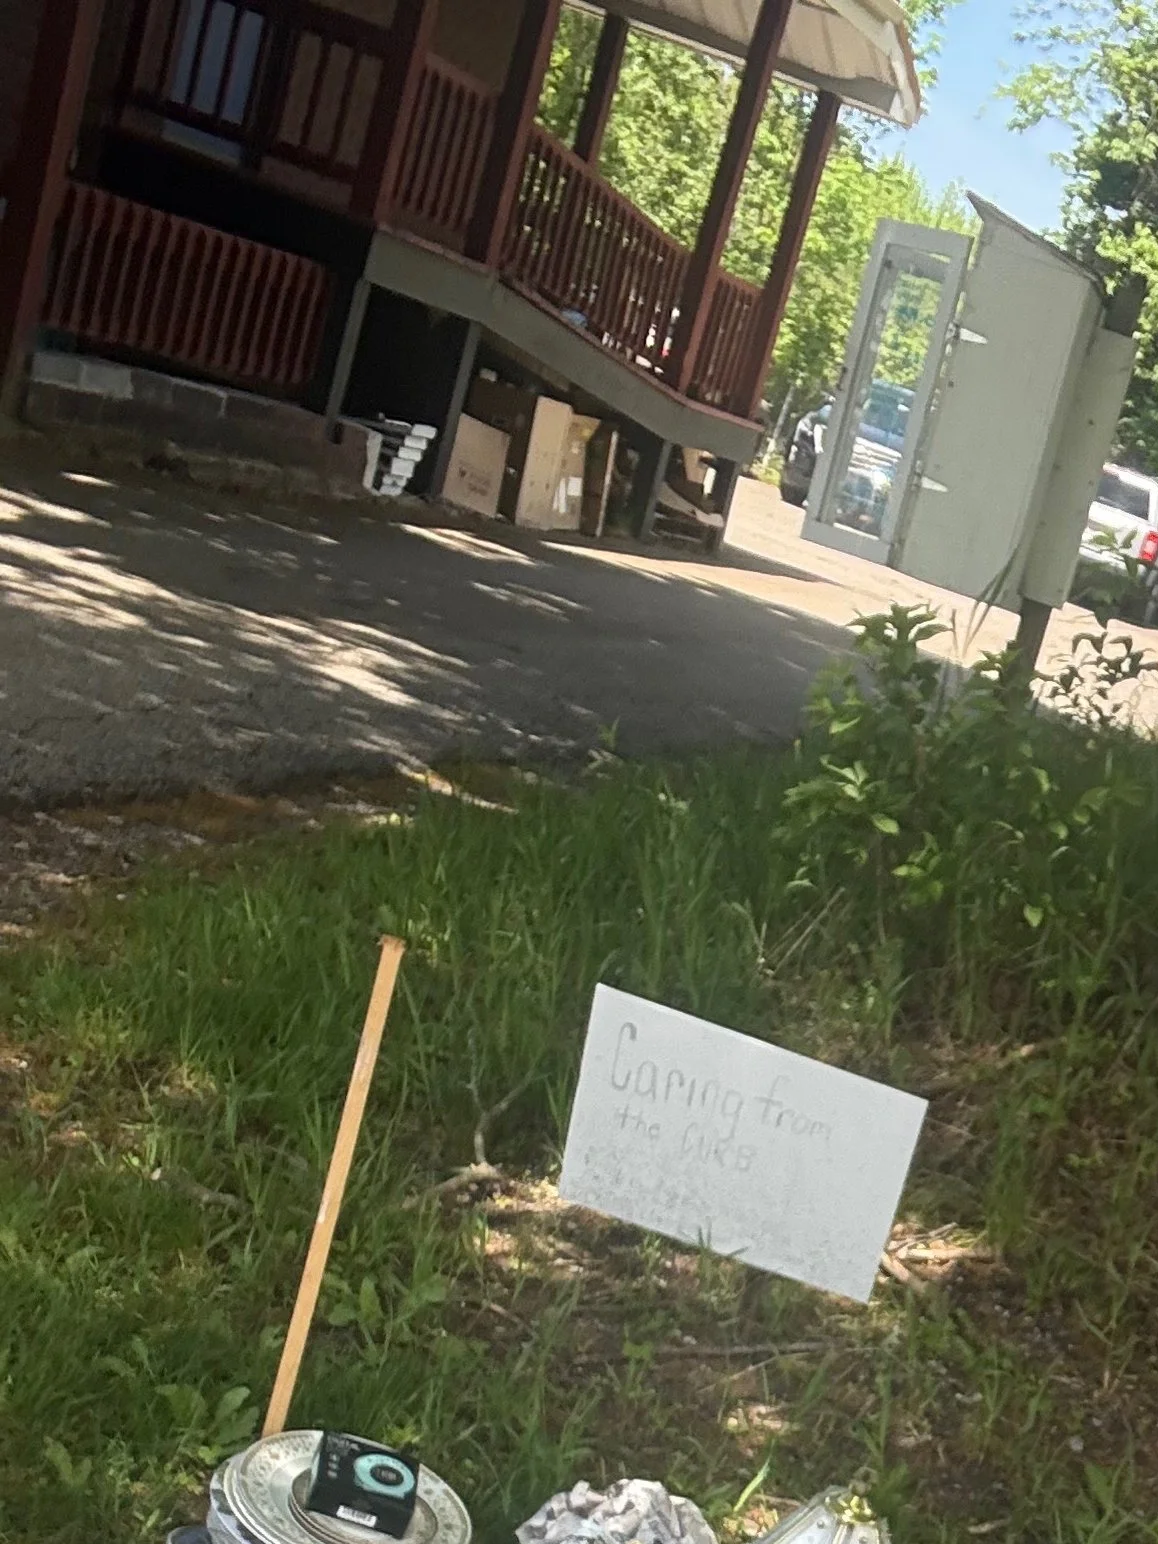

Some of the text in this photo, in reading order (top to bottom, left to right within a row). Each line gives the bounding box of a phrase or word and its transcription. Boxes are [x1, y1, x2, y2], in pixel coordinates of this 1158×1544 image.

[611, 1022, 833, 1142] Caring from
[617, 1103, 661, 1141] the
